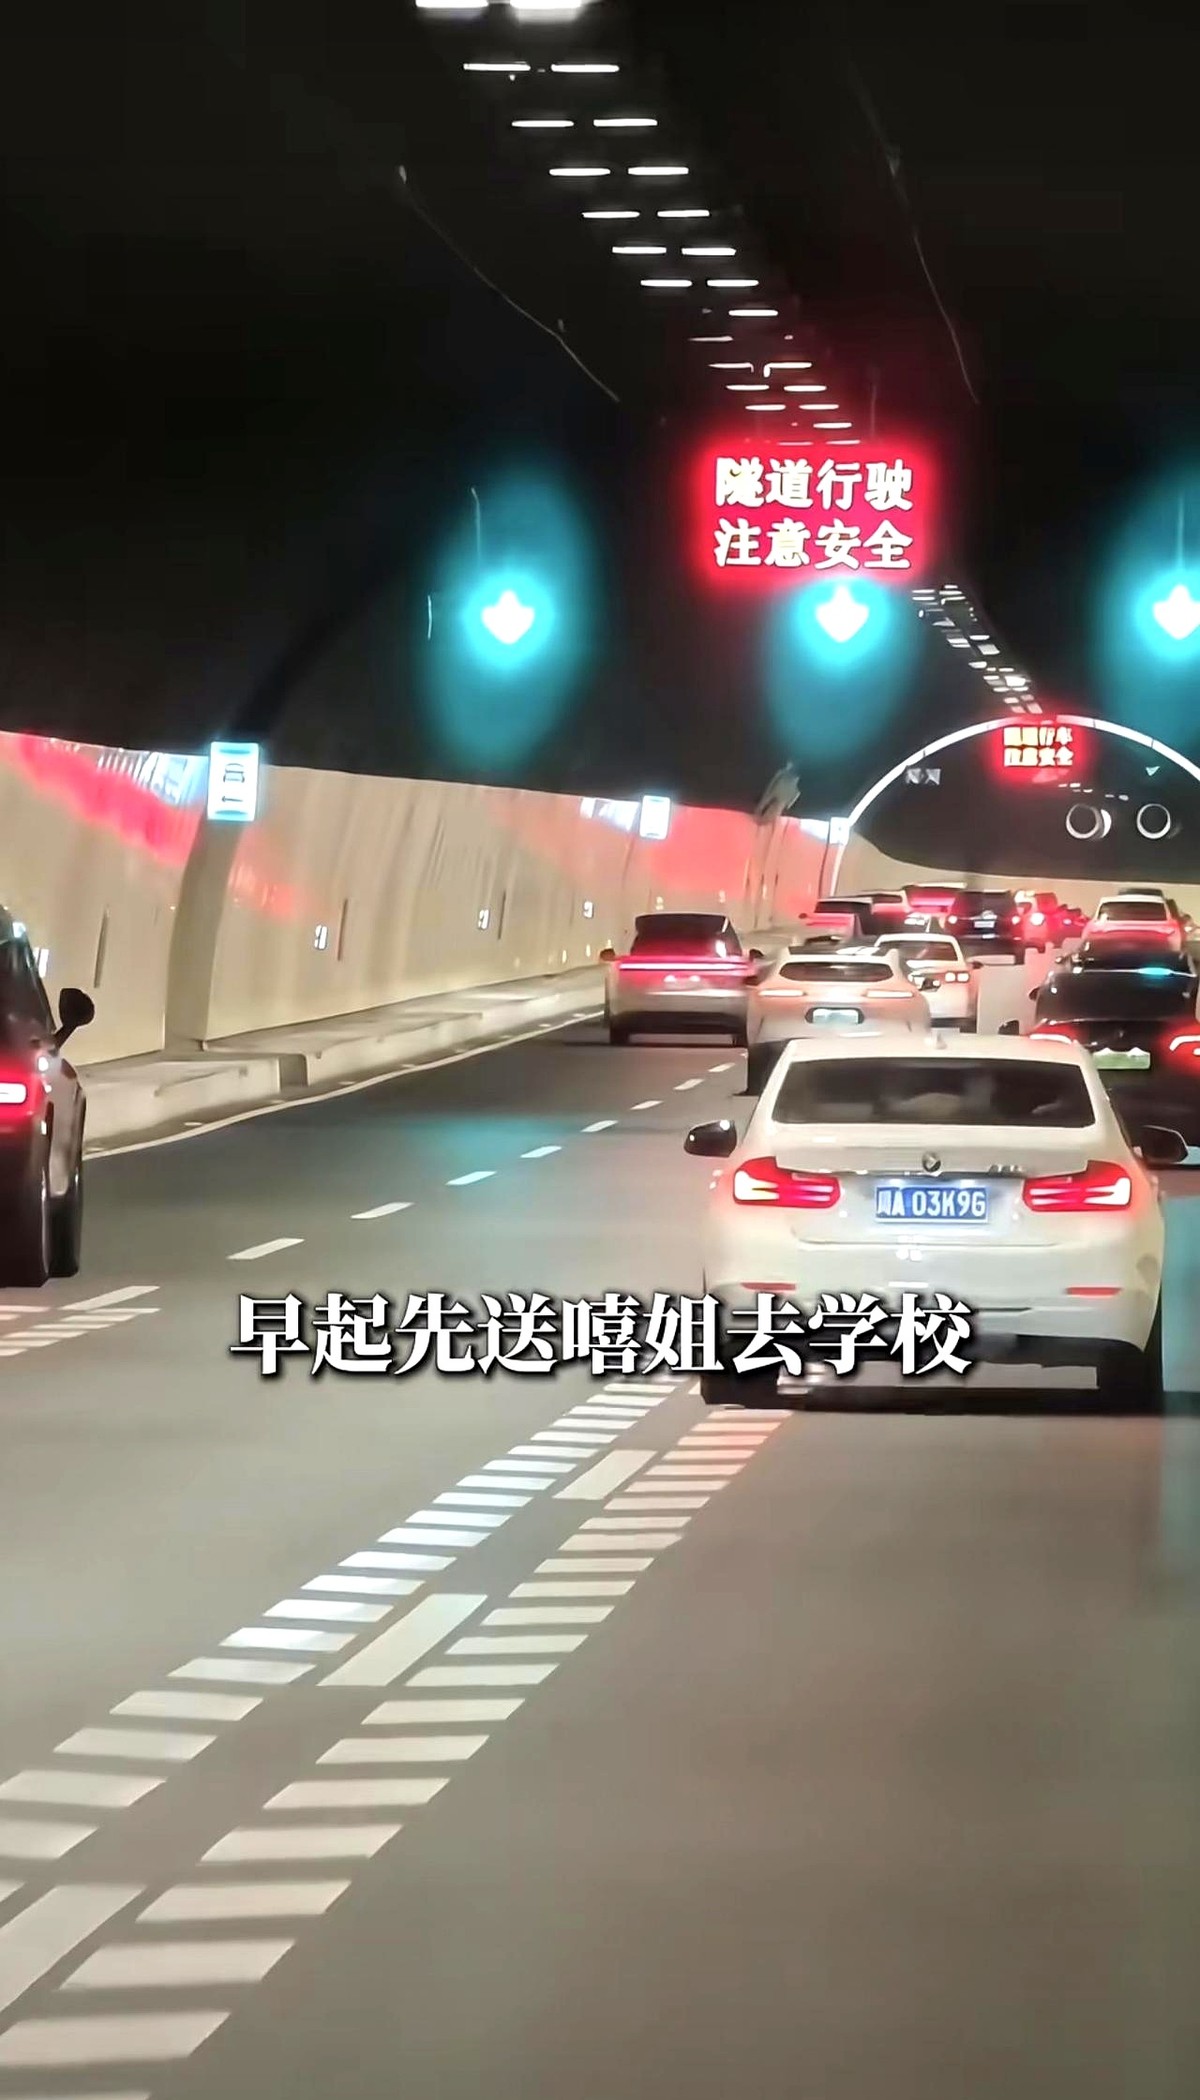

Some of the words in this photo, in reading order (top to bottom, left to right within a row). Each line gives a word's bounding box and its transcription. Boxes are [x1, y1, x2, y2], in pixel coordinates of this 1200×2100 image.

[715, 456, 913, 511] 隧道行驶
[713, 517, 913, 570] 注意安全
